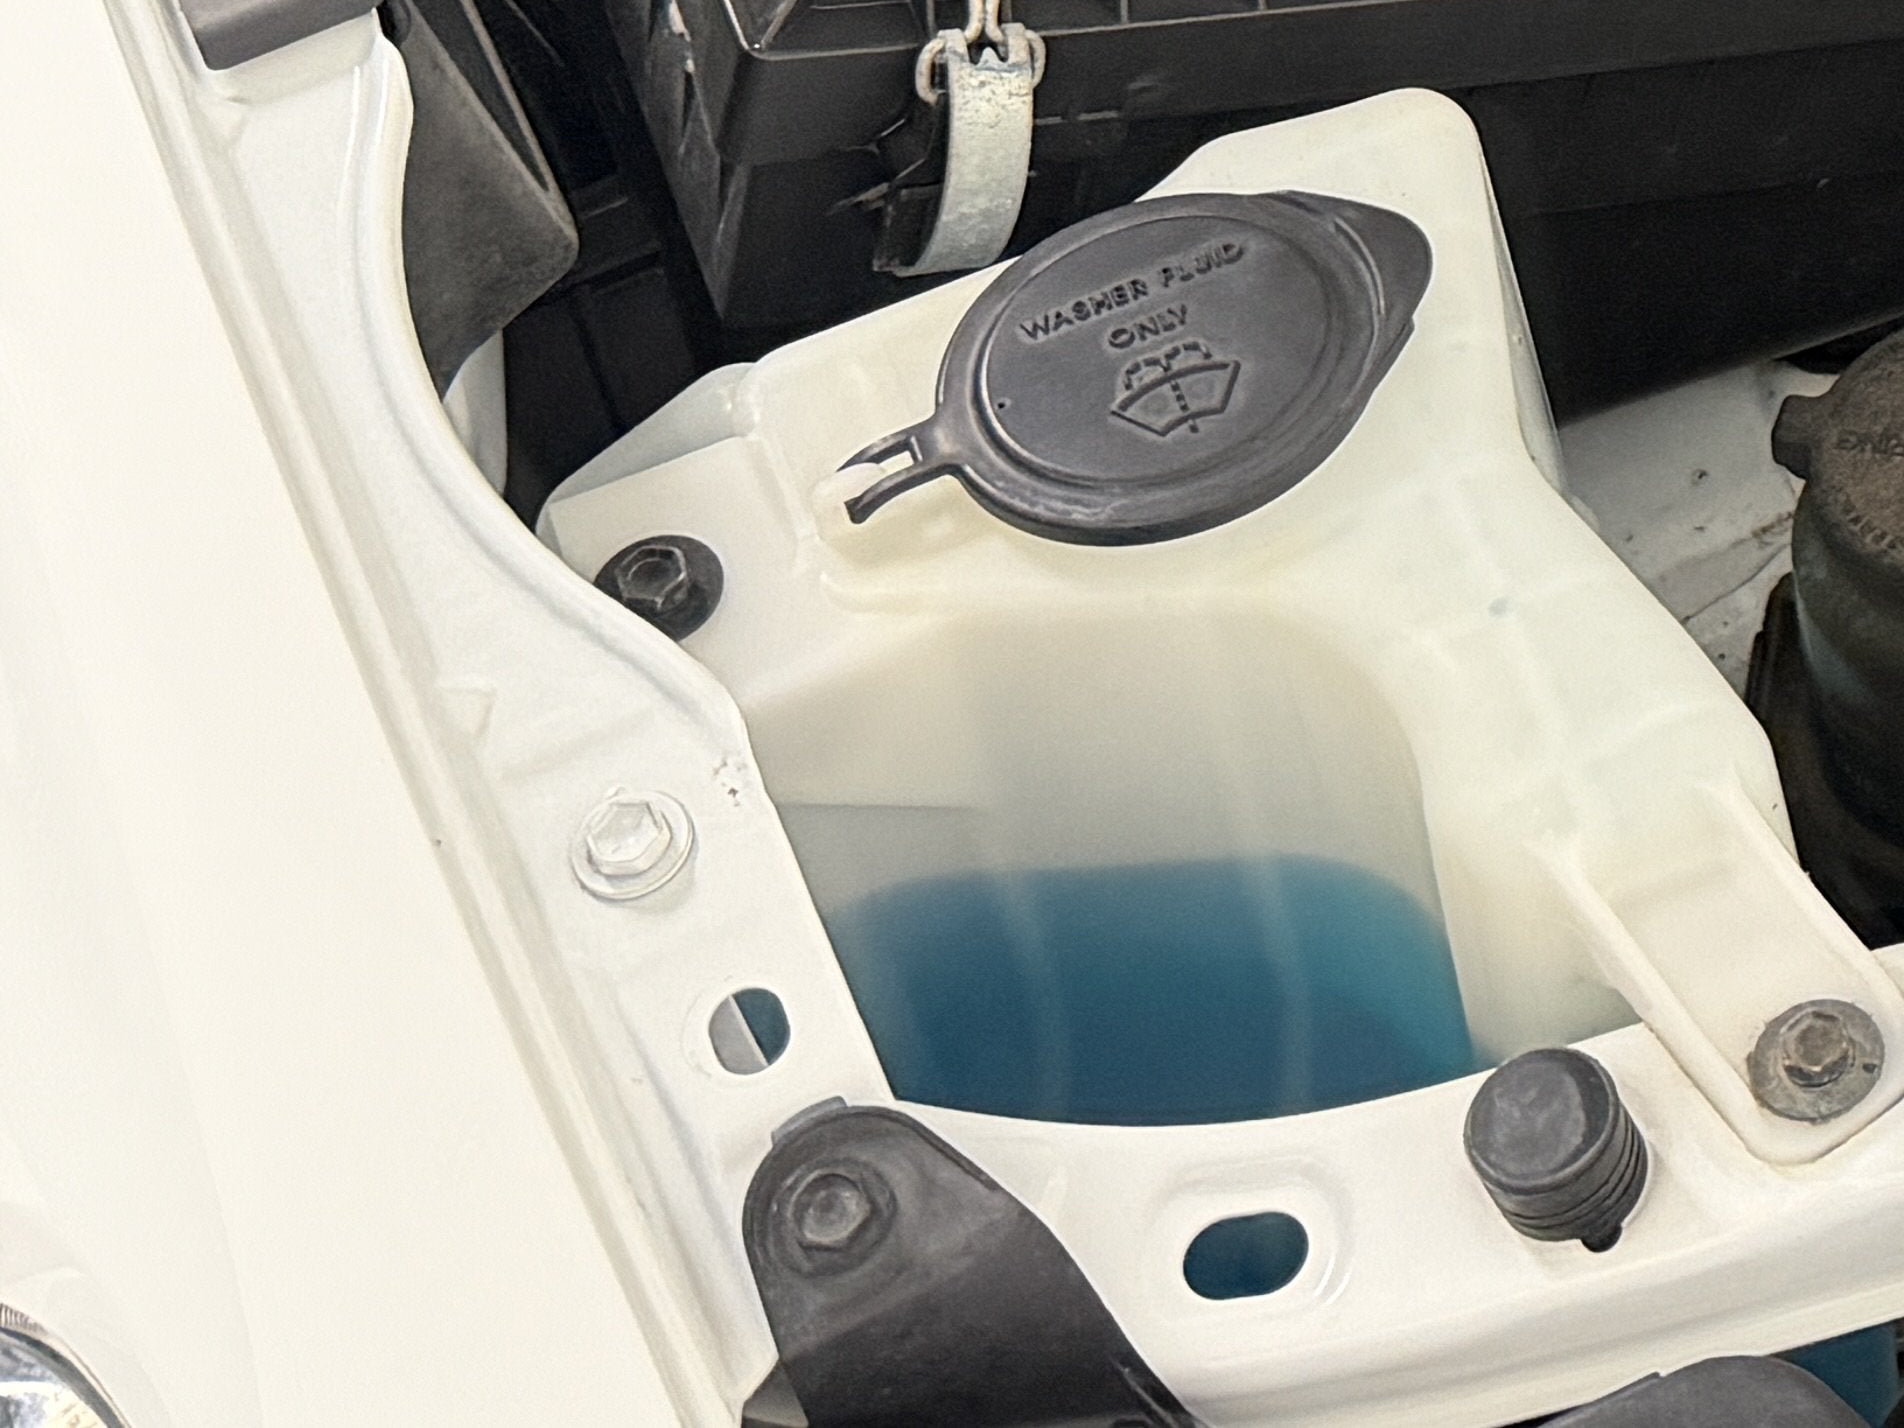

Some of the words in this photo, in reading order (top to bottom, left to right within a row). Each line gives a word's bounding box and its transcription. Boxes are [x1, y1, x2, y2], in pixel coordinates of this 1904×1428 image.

[1018, 277, 1150, 341] WASHER
[1159, 242, 1245, 288] FLUID
[1107, 302, 1189, 350] ONLY
